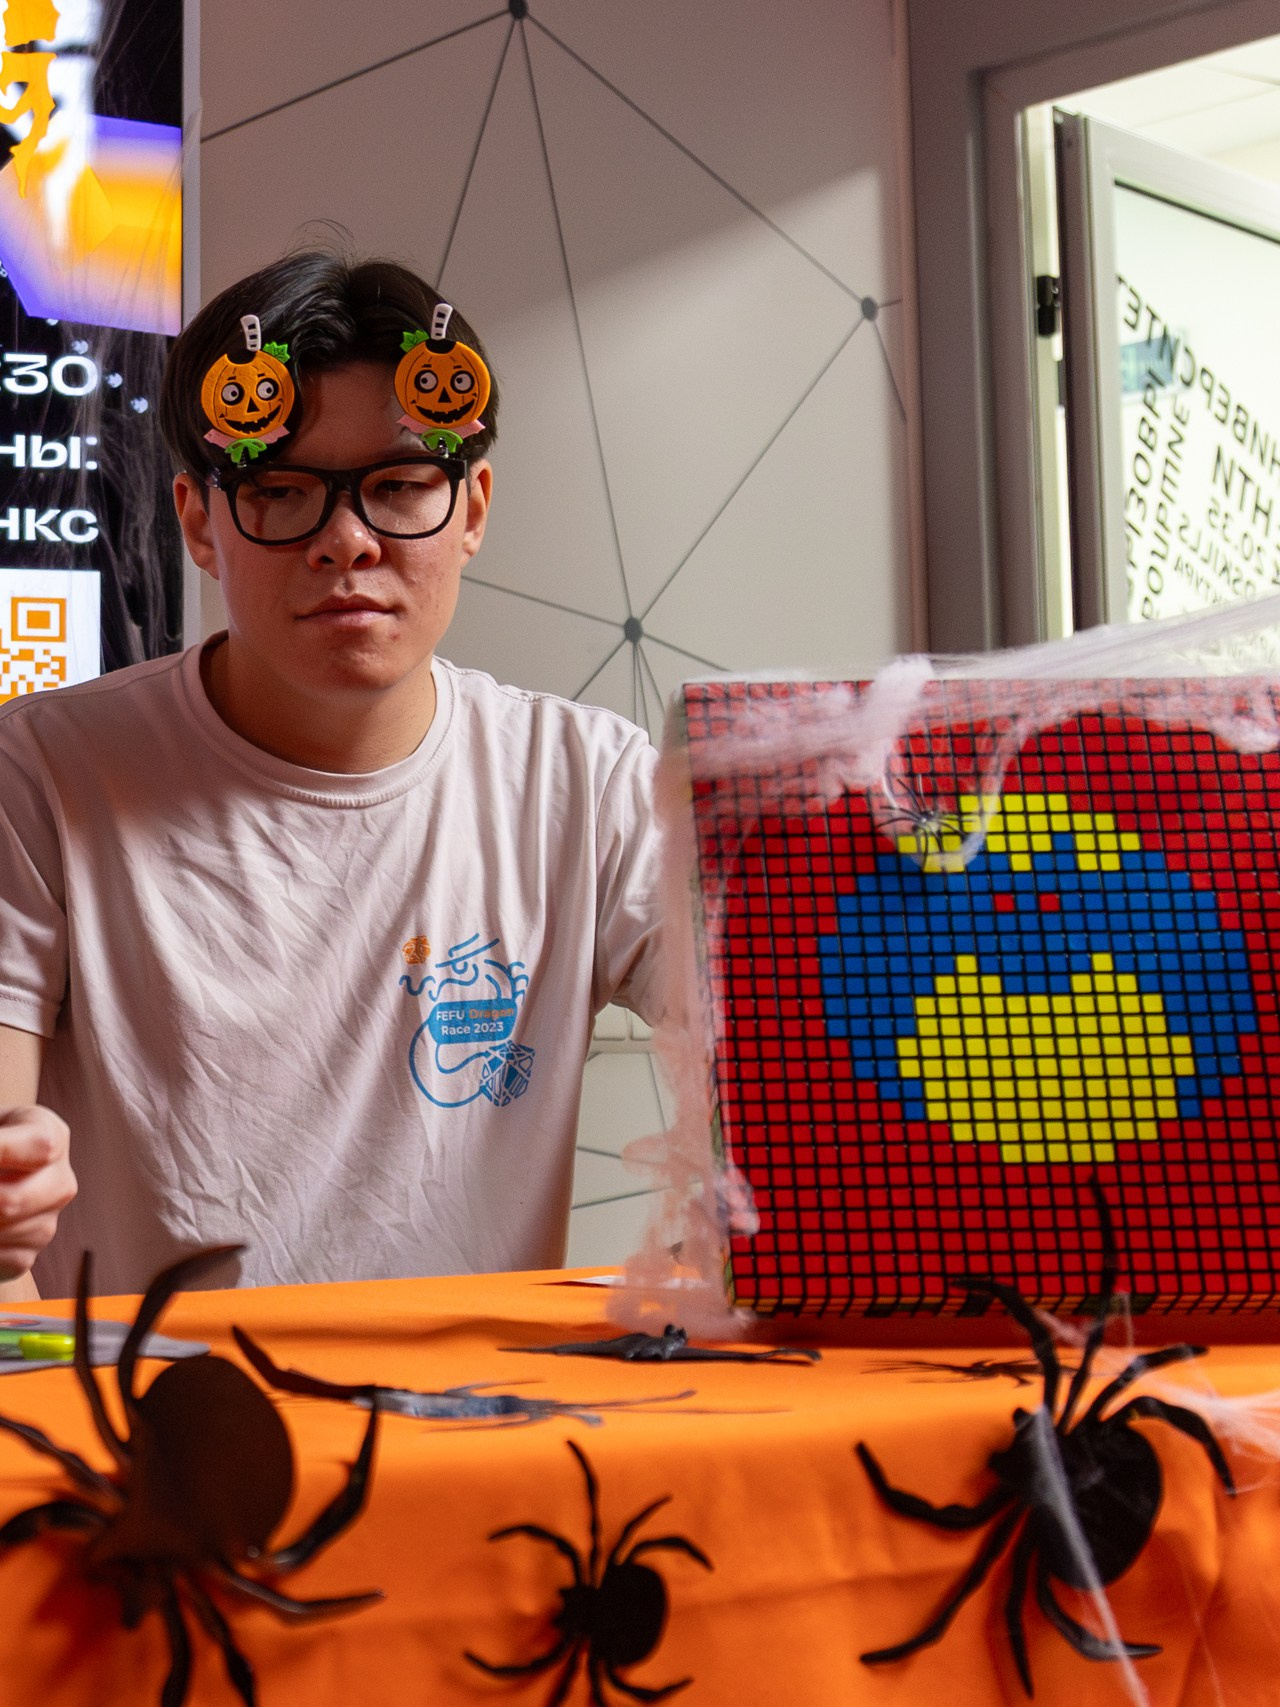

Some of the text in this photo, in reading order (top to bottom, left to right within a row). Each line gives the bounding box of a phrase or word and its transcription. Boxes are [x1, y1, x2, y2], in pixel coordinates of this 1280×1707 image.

[436, 1008, 514, 1021] FEFU Dragon
[441, 1022, 504, 1035] Race 2023
